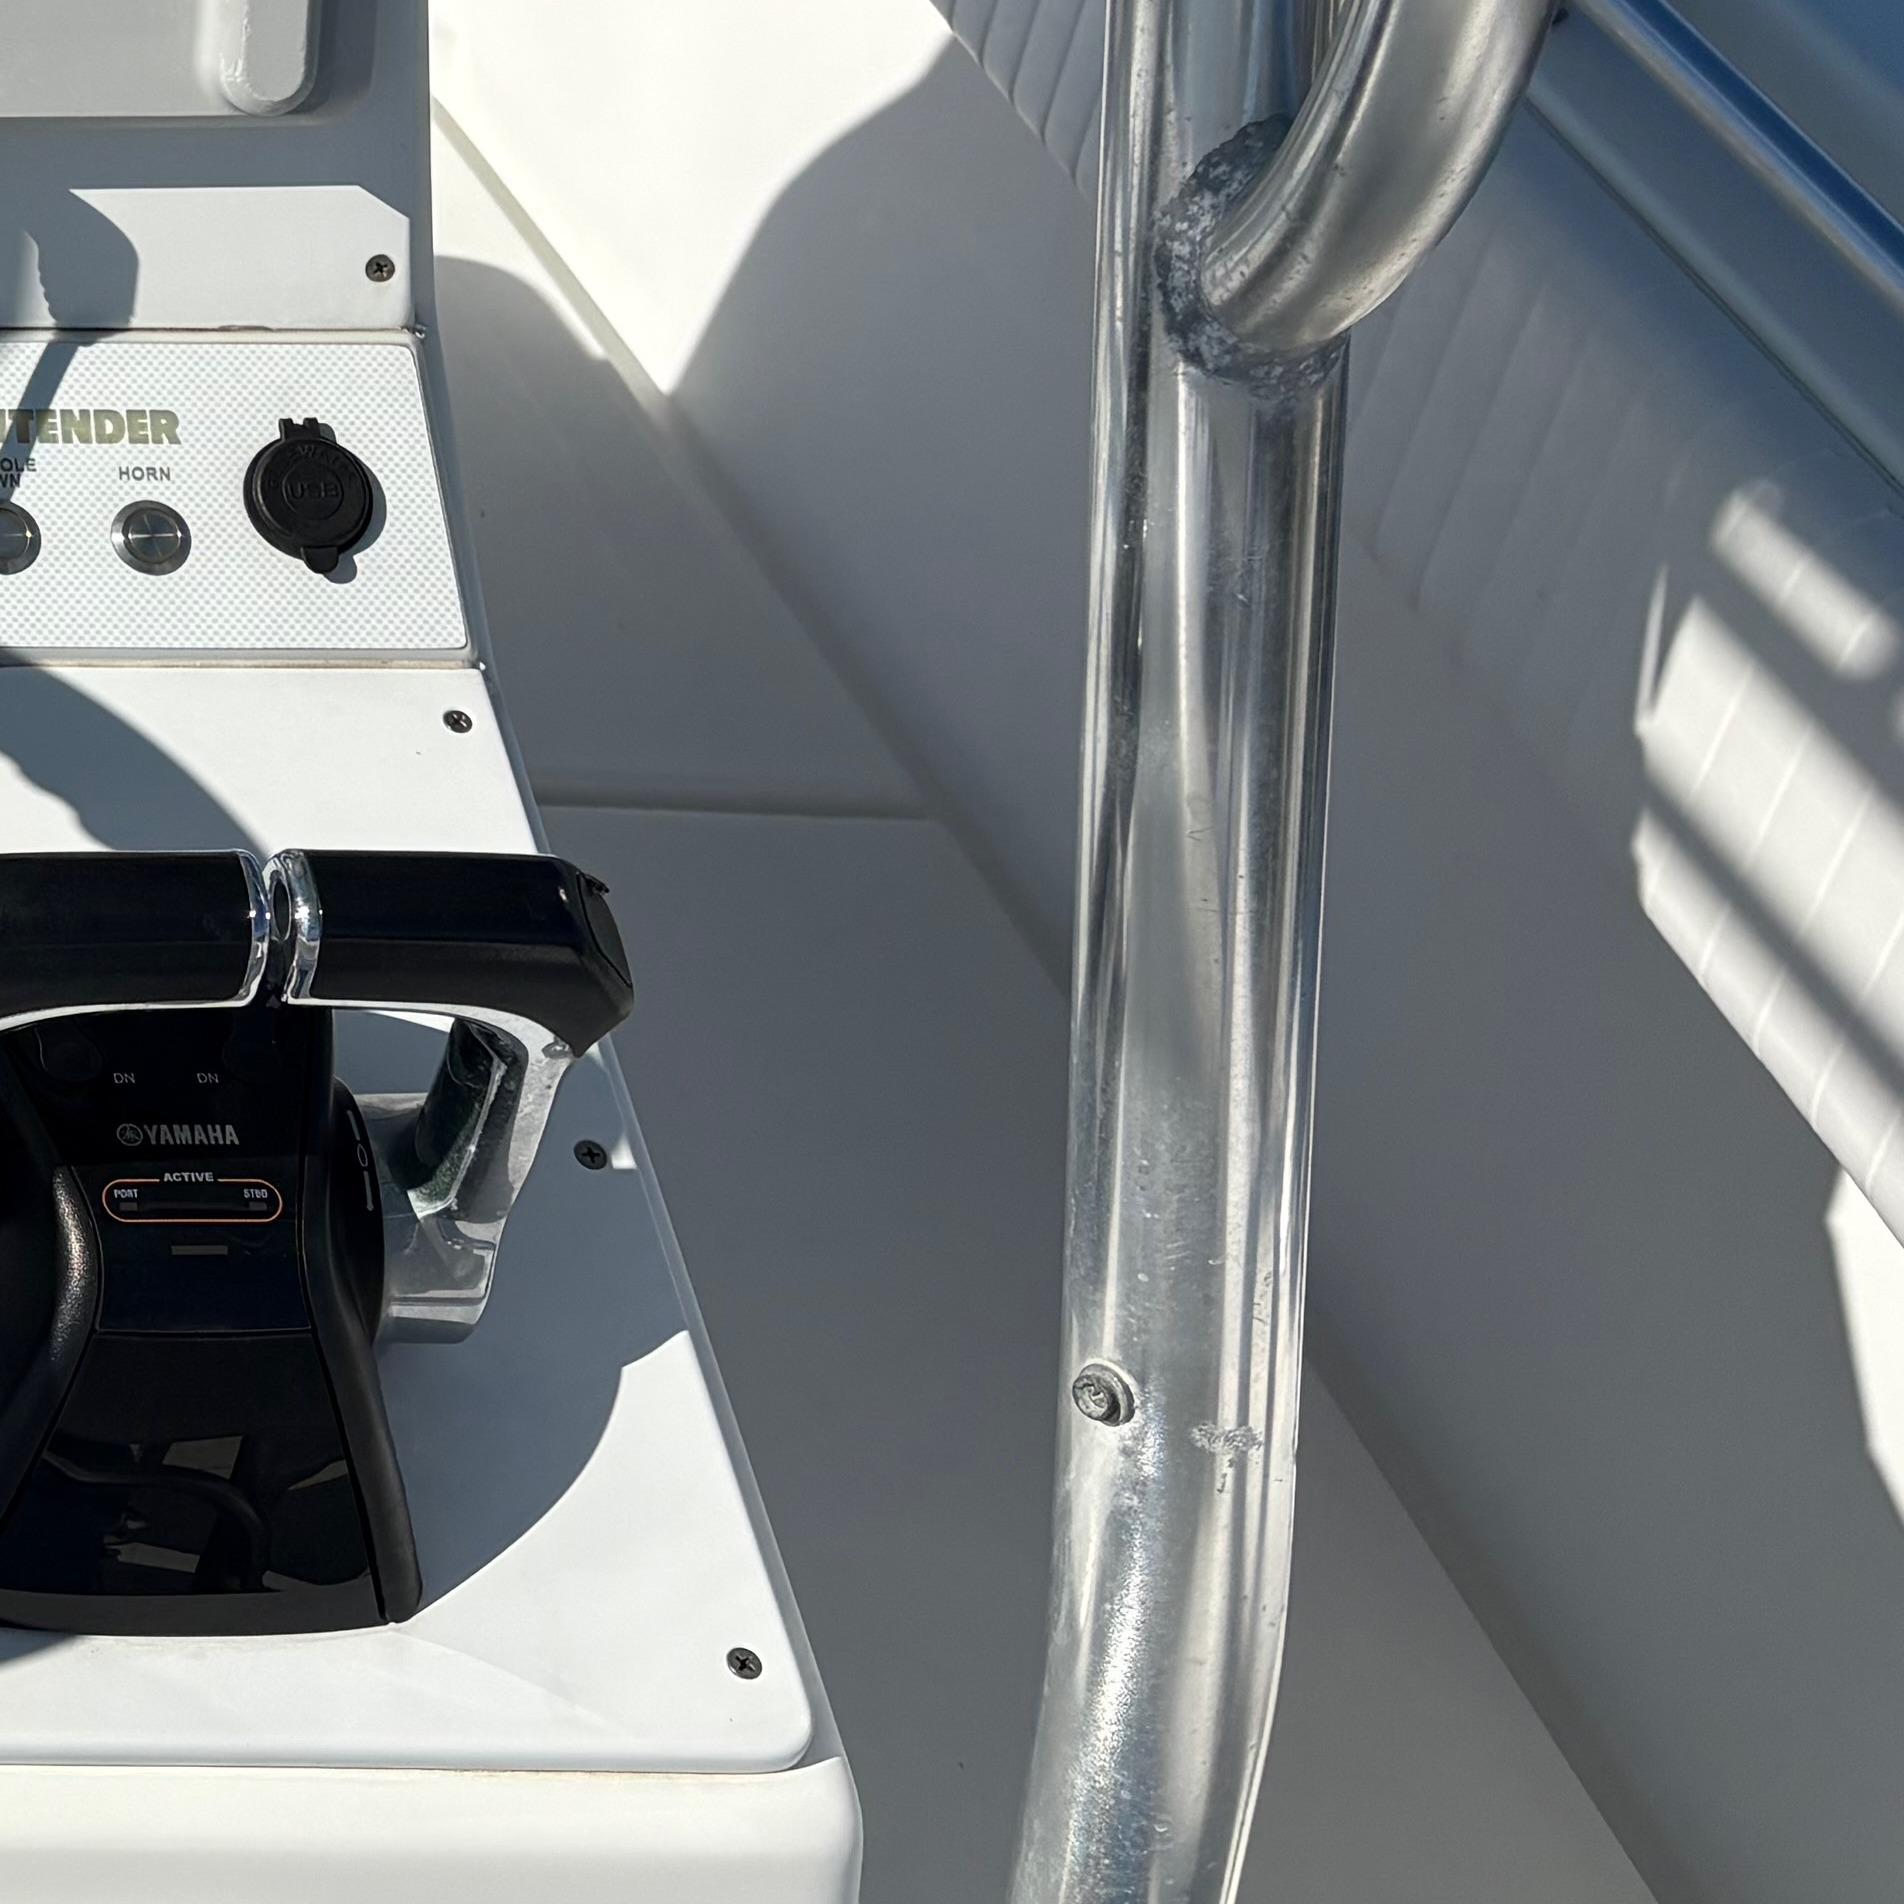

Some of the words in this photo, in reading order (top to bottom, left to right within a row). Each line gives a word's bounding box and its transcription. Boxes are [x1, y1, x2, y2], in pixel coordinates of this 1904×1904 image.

[118, 466, 172, 482] HORN
[113, 1072, 136, 1084] DN
[196, 1072, 220, 1084] DN
[143, 1124, 241, 1146] YAMAHA
[163, 1171, 215, 1183] ACTIVE
[113, 1188, 139, 1199] PORT
[243, 1188, 269, 1199] STBD
